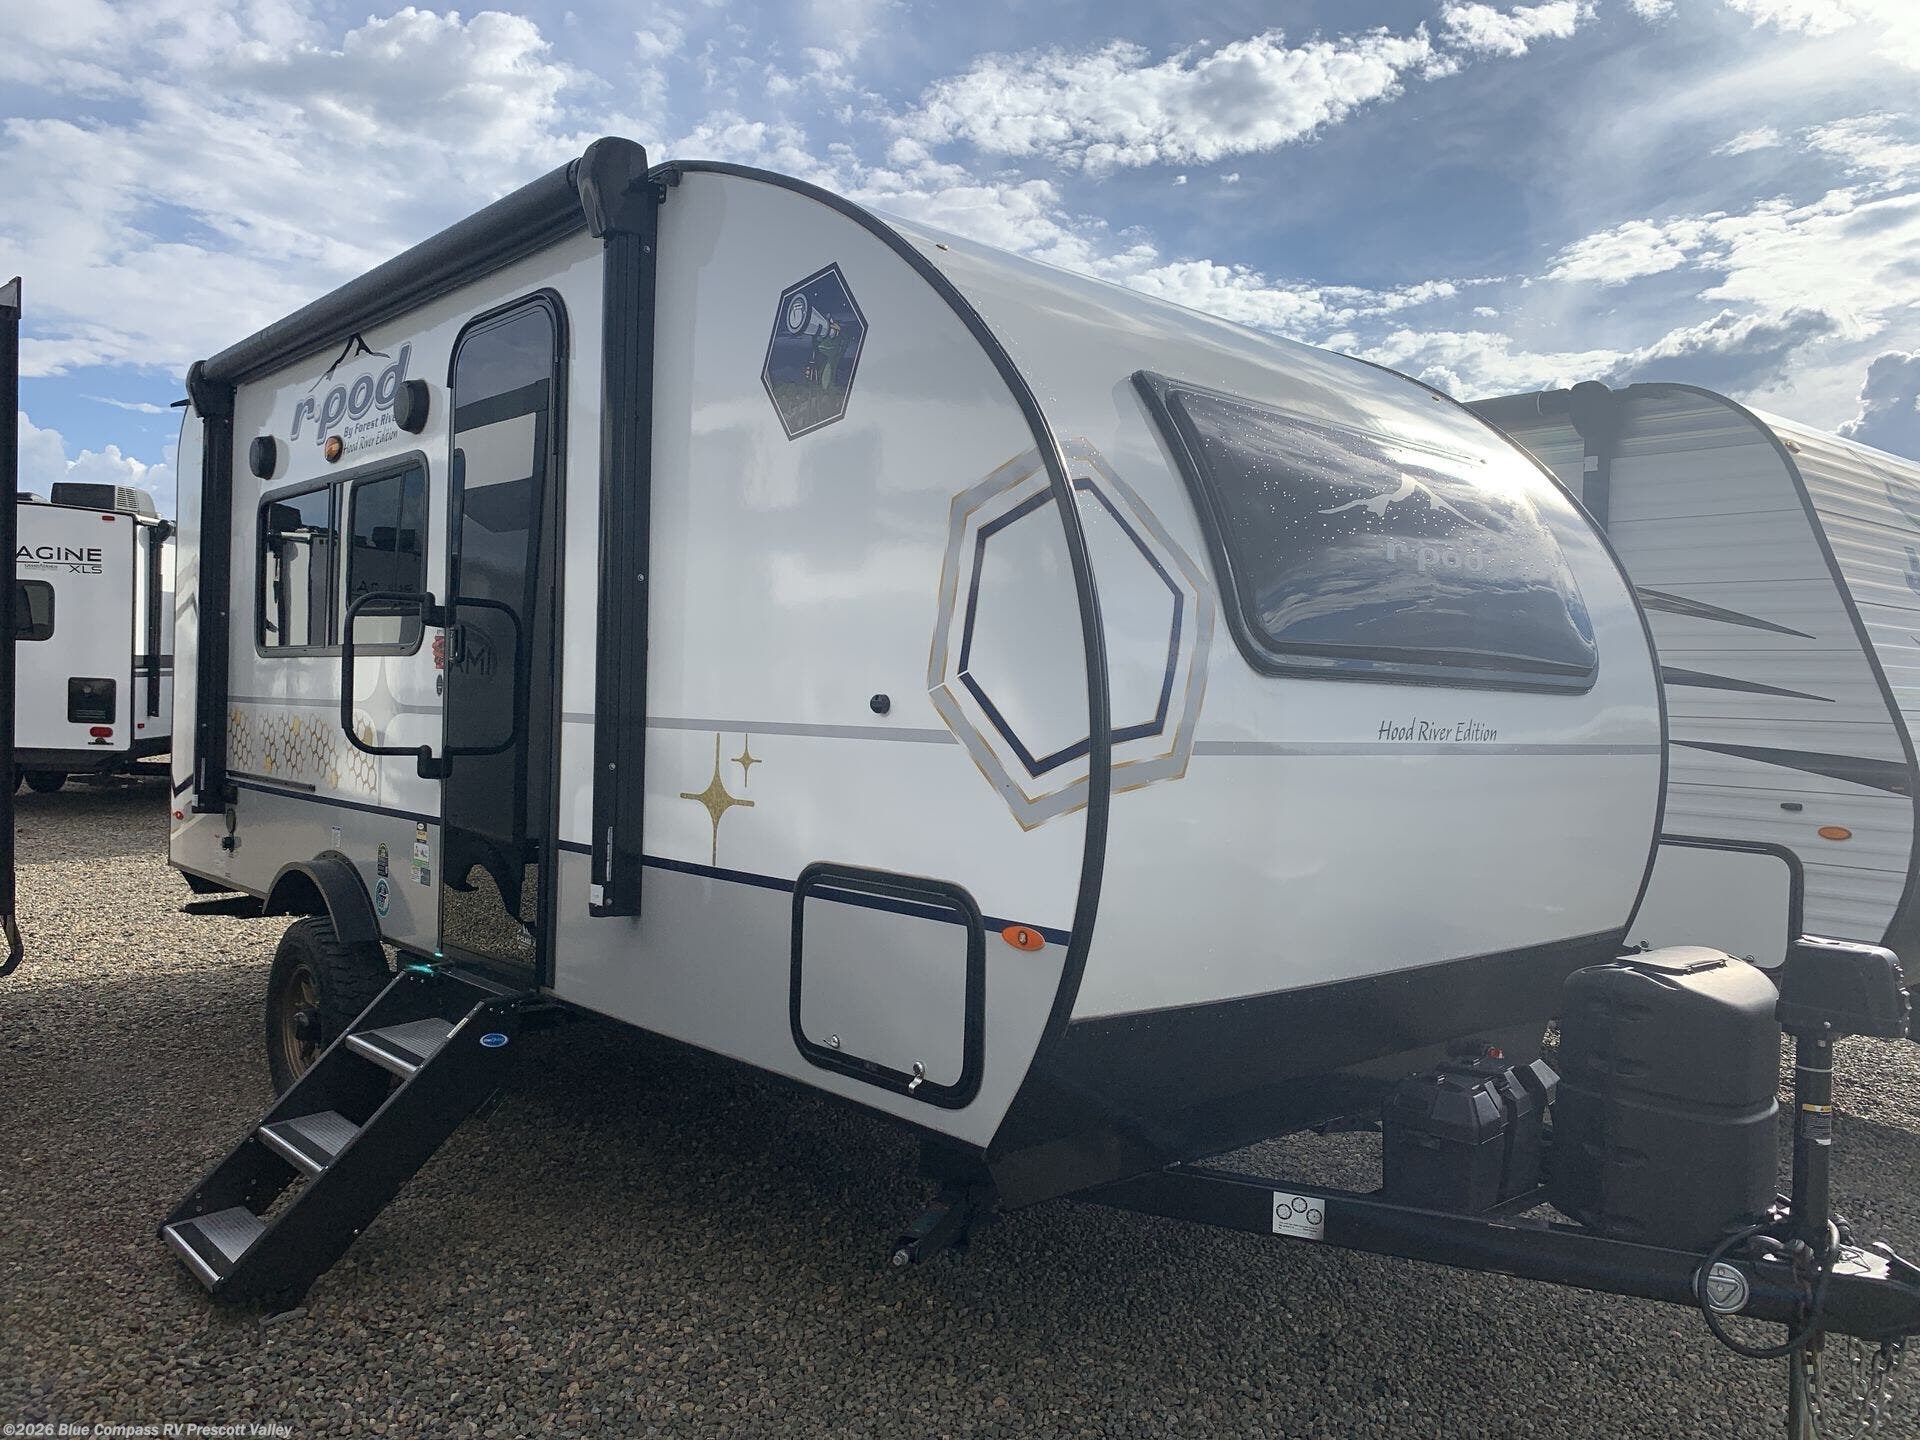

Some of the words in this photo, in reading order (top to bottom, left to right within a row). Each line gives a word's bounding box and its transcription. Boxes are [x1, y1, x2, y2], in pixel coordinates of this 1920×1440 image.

[344, 426, 354, 439] By
[354, 418, 379, 434] Forest
[380, 413, 397, 426] Rive
[69, 564, 103, 575] XLS
[1378, 717, 1416, 741] Hood
[1418, 720, 1453, 741] River
[1455, 718, 1497, 742] Edition
